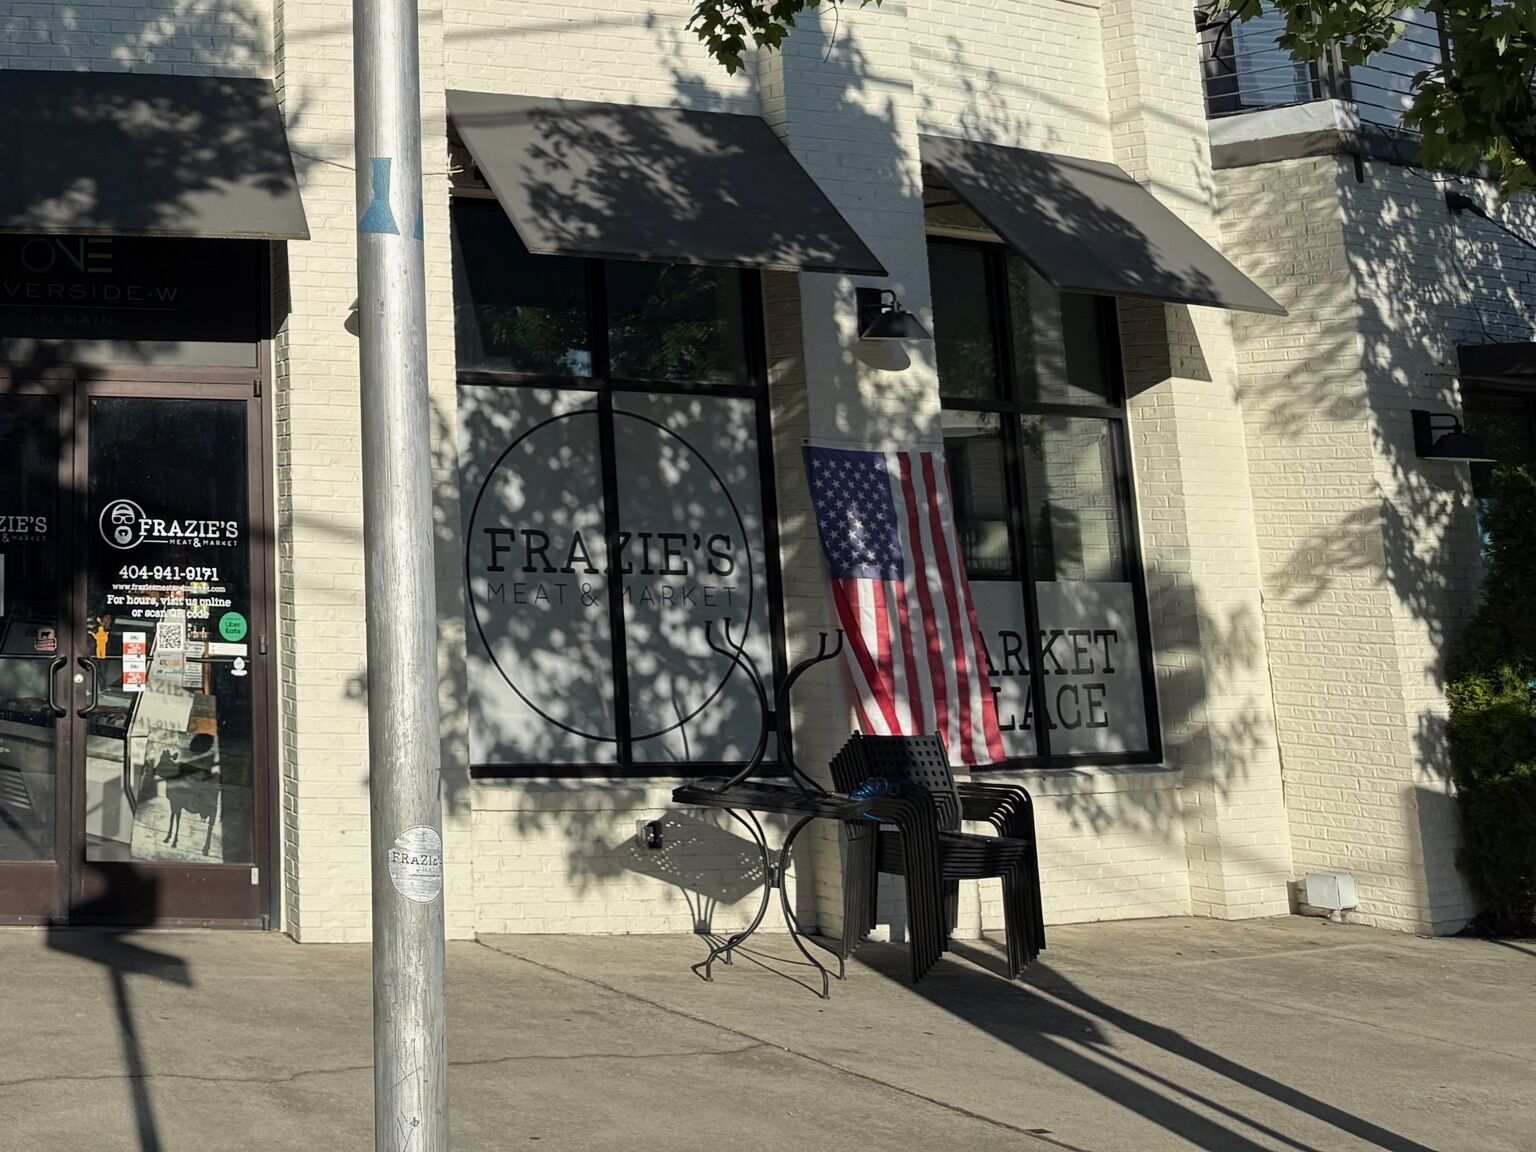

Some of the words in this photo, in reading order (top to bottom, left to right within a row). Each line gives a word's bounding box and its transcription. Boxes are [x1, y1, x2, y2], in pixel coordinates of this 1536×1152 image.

[138, 518, 239, 539] FRAZIE'S
[483, 528, 734, 577] FRAZIE'S
[119, 565, 220, 582] 404-941-9171
[107, 594, 125, 605] For
[126, 595, 159, 607] hours,
[160, 596, 184, 607] visit
[185, 598, 198, 607] us
[199, 597, 232, 608] online
[487, 582, 568, 605] MEAT
[580, 582, 599, 607] &
[131, 609, 144, 618] or
[145, 609, 166, 618] scan
[186, 608, 210, 619] code
[225, 620, 241, 628] Uber
